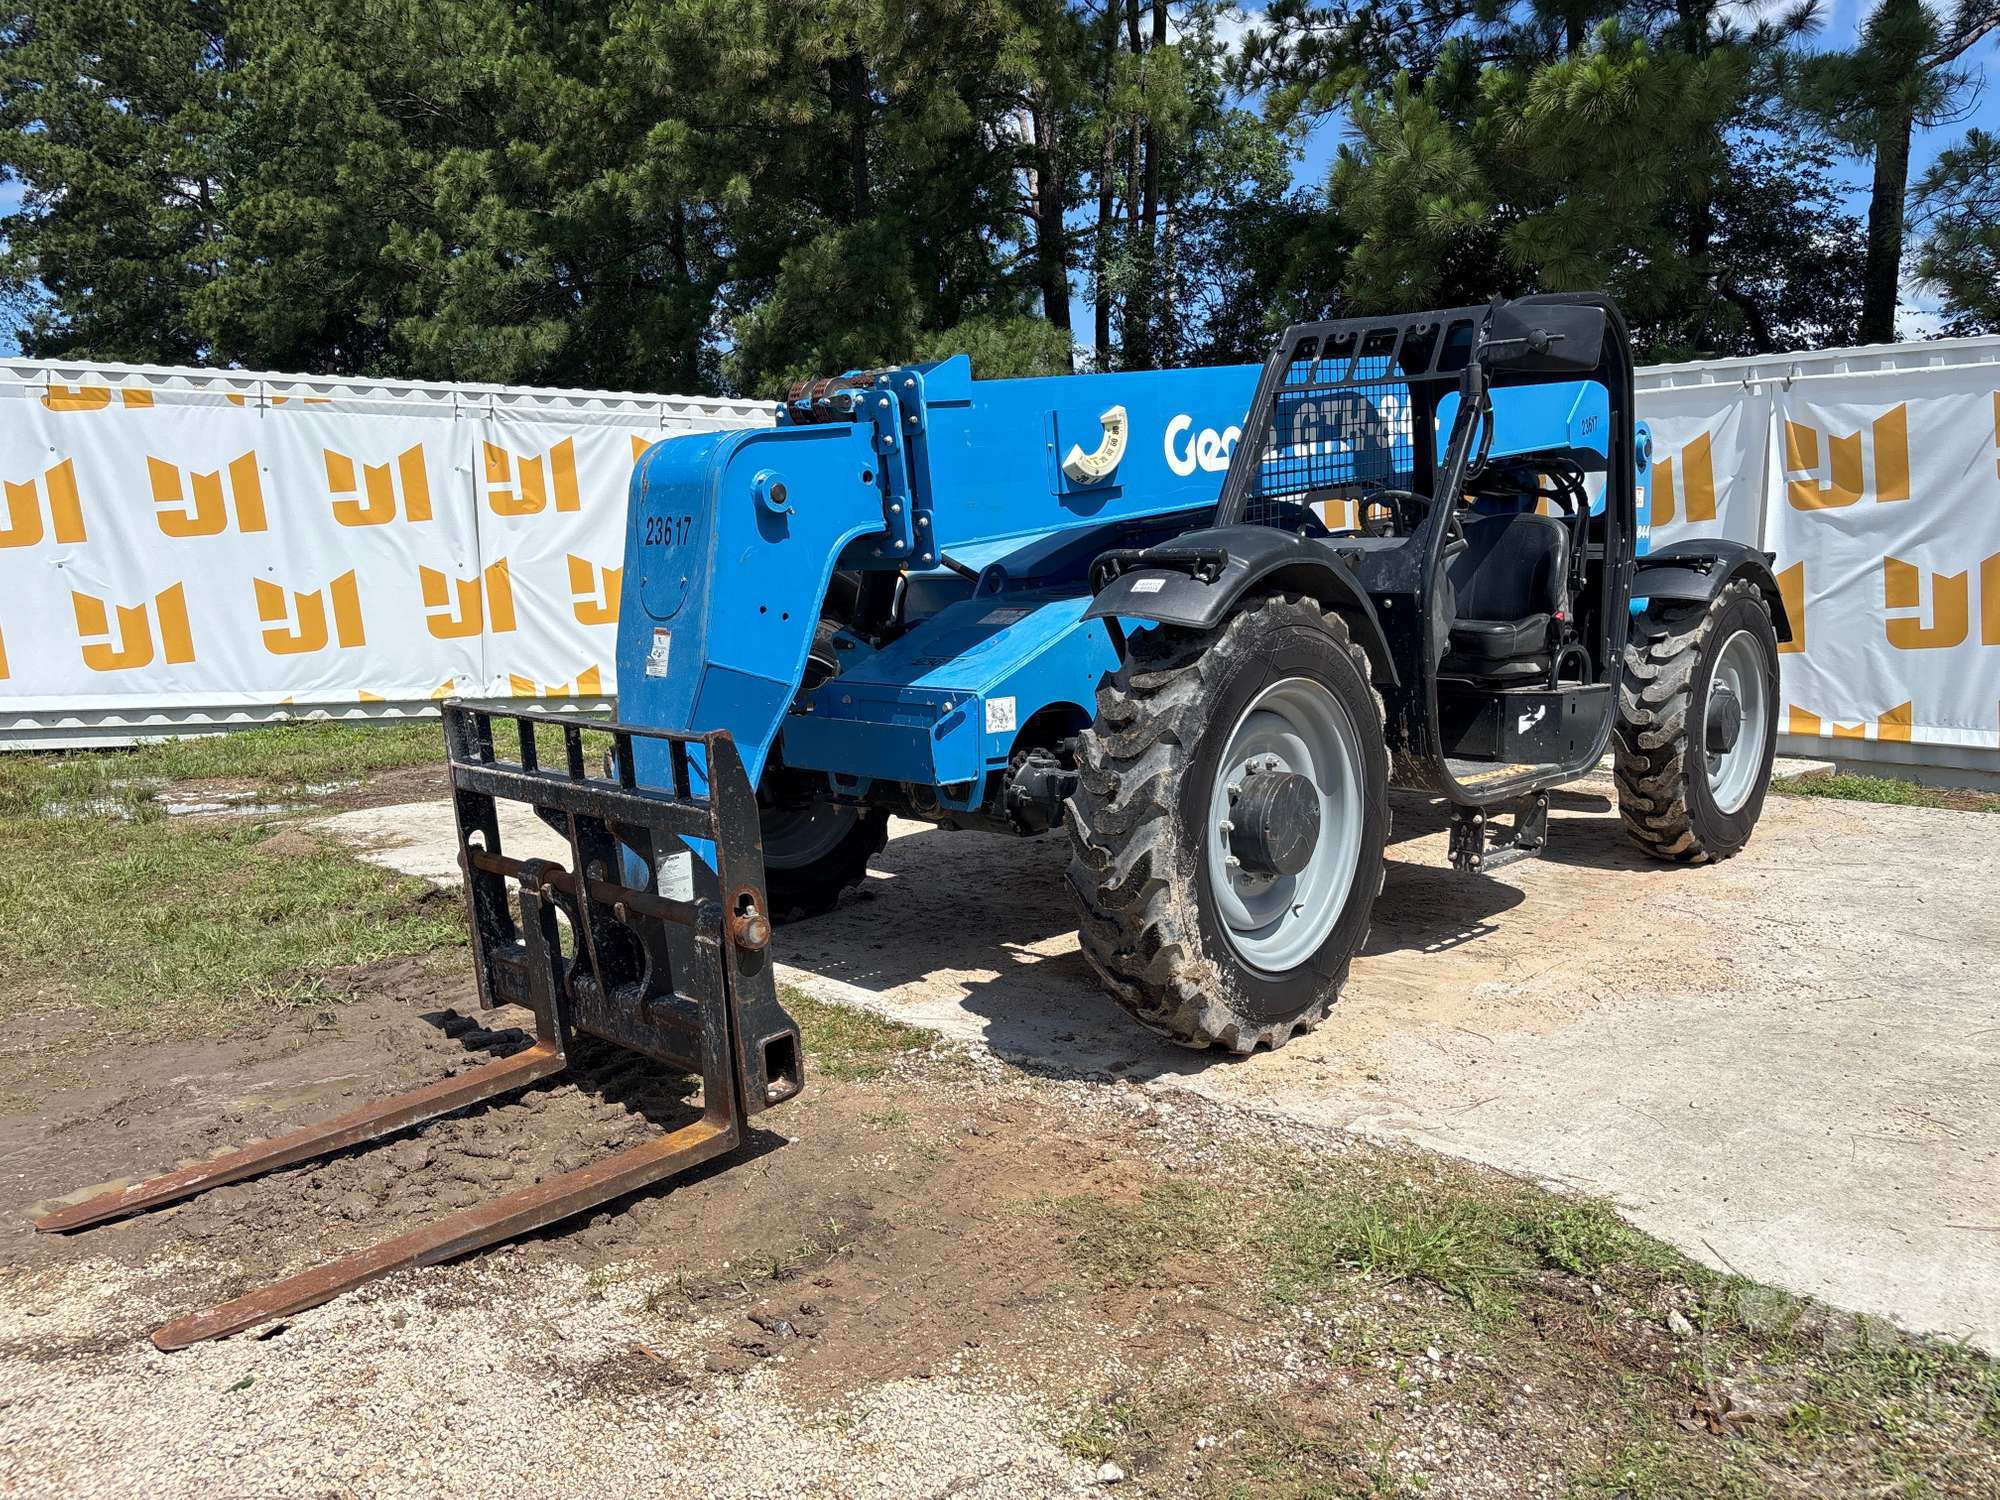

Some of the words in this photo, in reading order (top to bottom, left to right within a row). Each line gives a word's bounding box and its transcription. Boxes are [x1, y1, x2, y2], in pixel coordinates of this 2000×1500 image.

[1292, 393, 1440, 460] GTH-84
[1581, 415, 1598, 438] 23617
[645, 515, 692, 546] 23617
